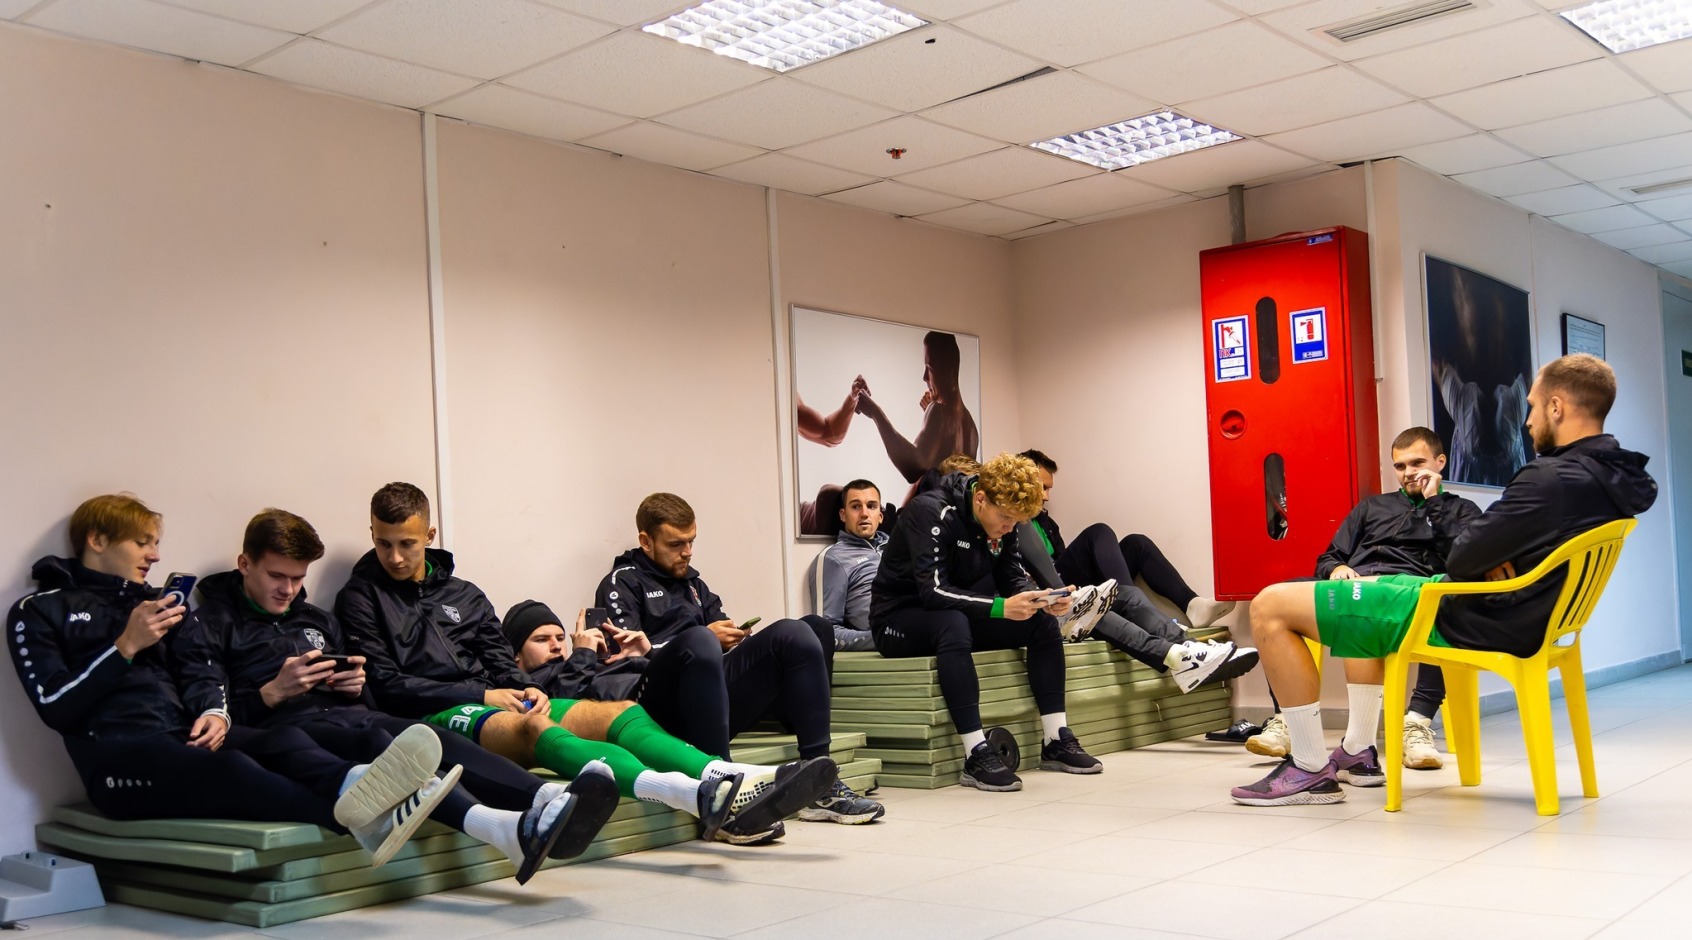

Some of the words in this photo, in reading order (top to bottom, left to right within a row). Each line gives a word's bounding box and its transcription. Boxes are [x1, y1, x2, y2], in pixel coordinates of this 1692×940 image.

[956, 539, 970, 549] JAKO
[646, 590, 664, 598] JAKO
[1352, 581, 1361, 600] JAKO
[69, 612, 91, 622] JAKO
